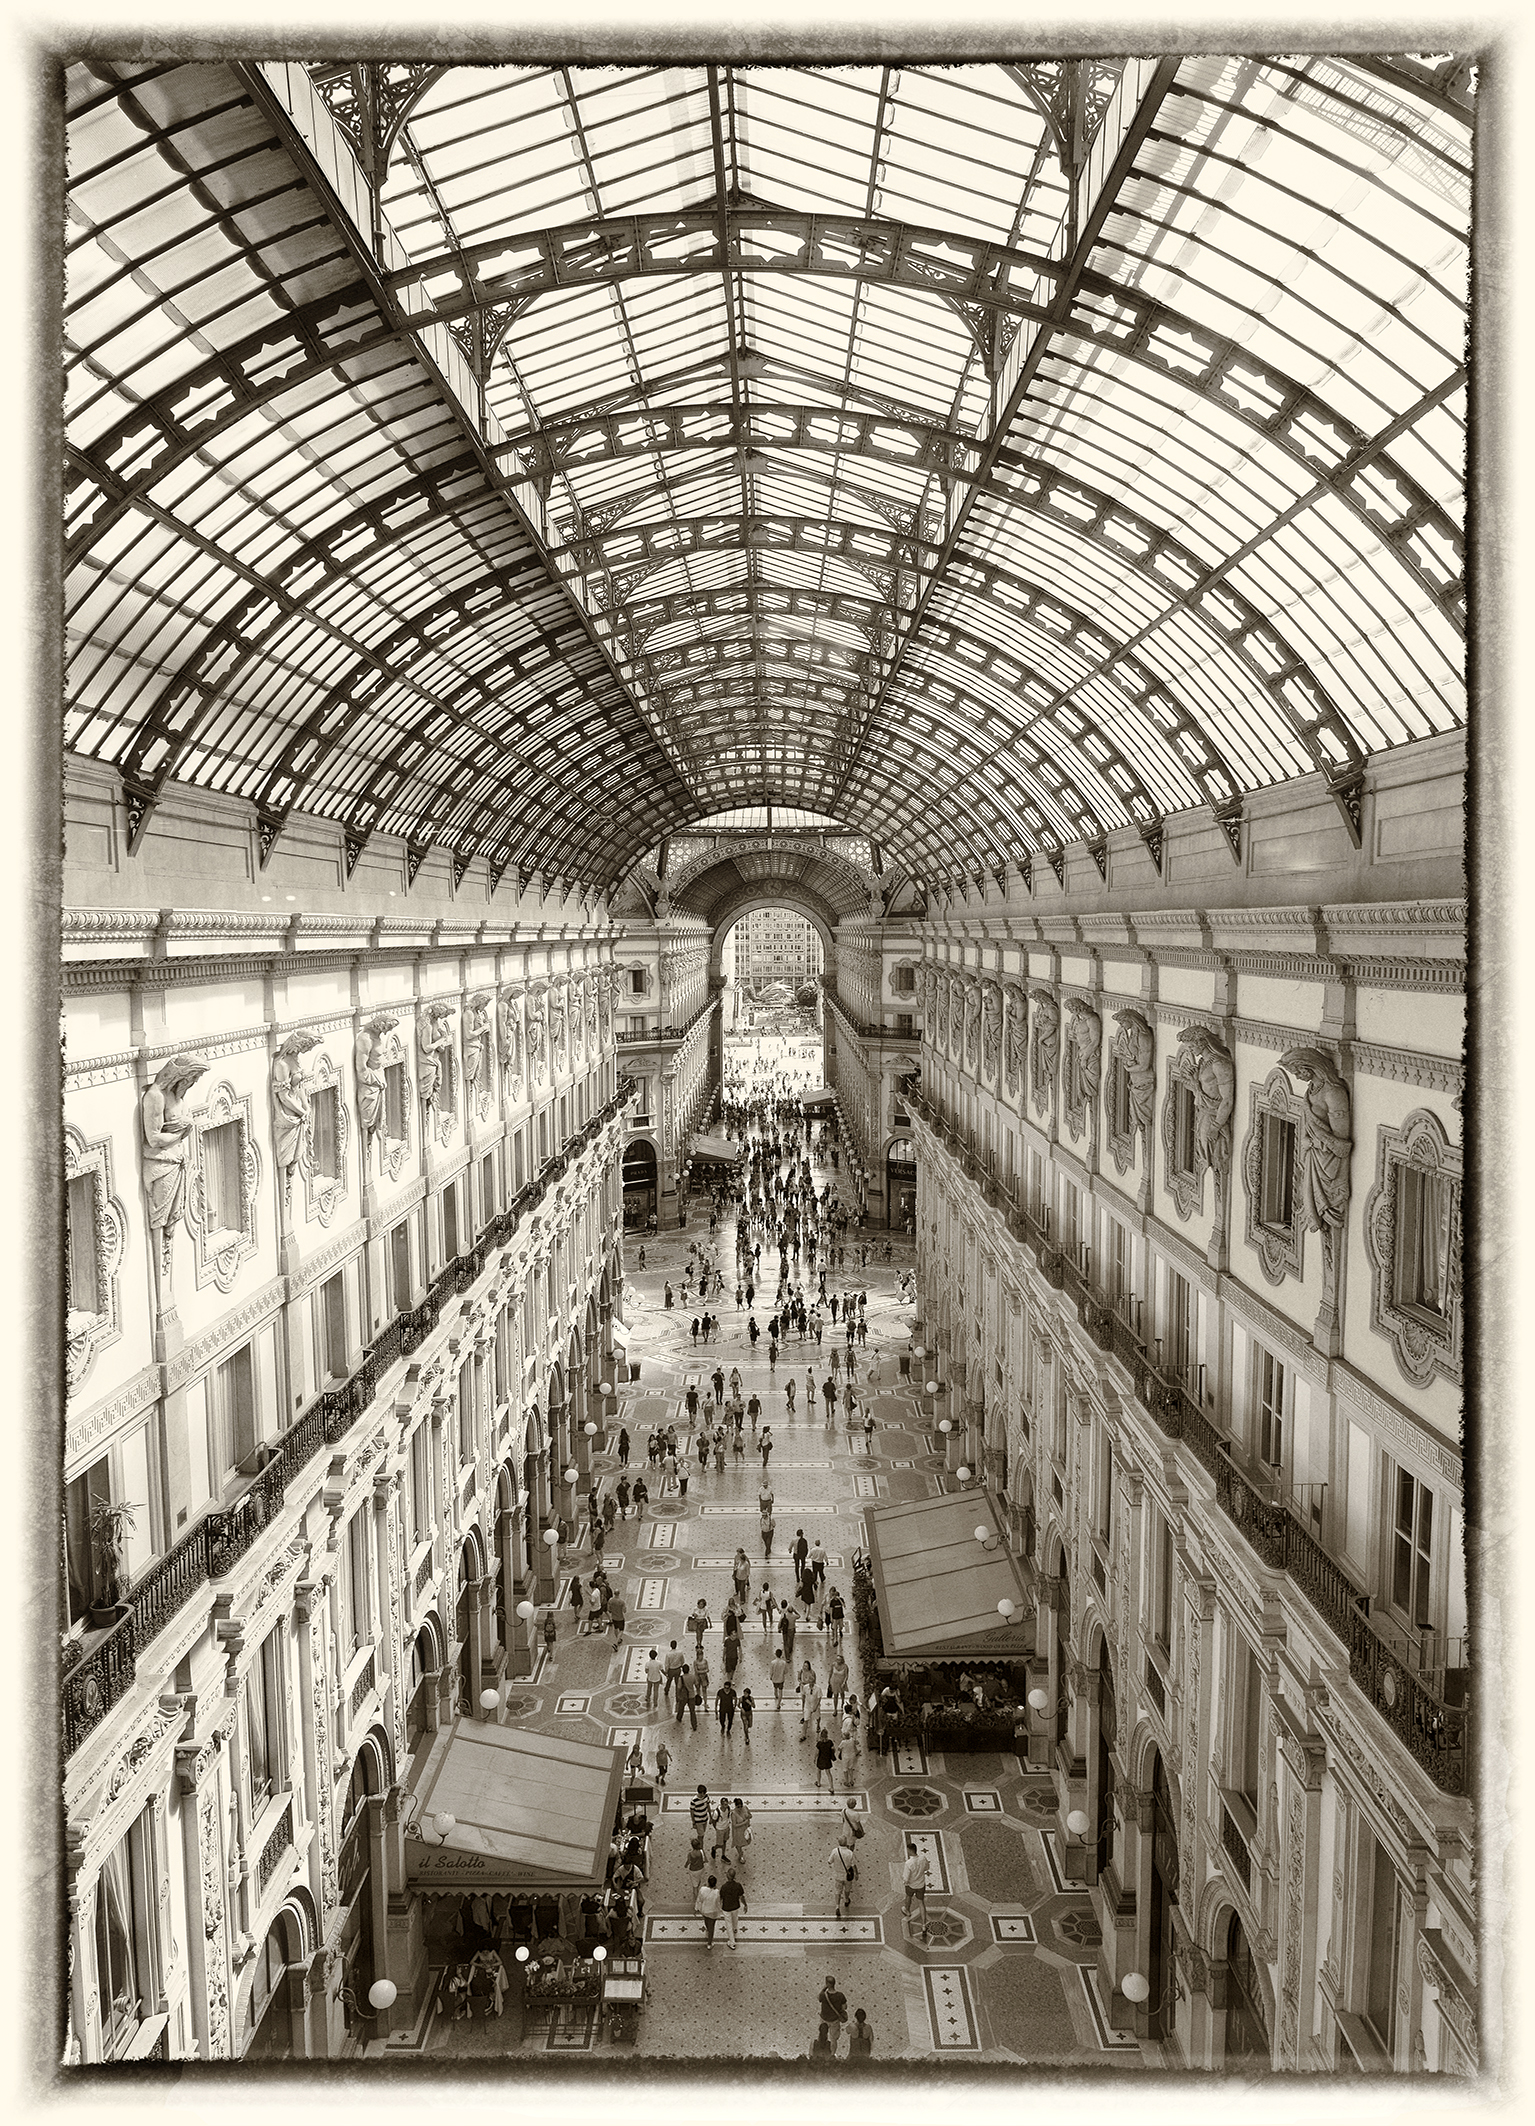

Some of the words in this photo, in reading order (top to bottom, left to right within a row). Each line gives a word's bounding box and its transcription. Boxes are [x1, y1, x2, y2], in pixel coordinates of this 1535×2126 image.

[890, 1167, 916, 1176] VERSAC
[983, 1631, 1026, 1643] Galleria
[418, 1855, 431, 1868] il
[434, 1855, 486, 1868] Salotto
